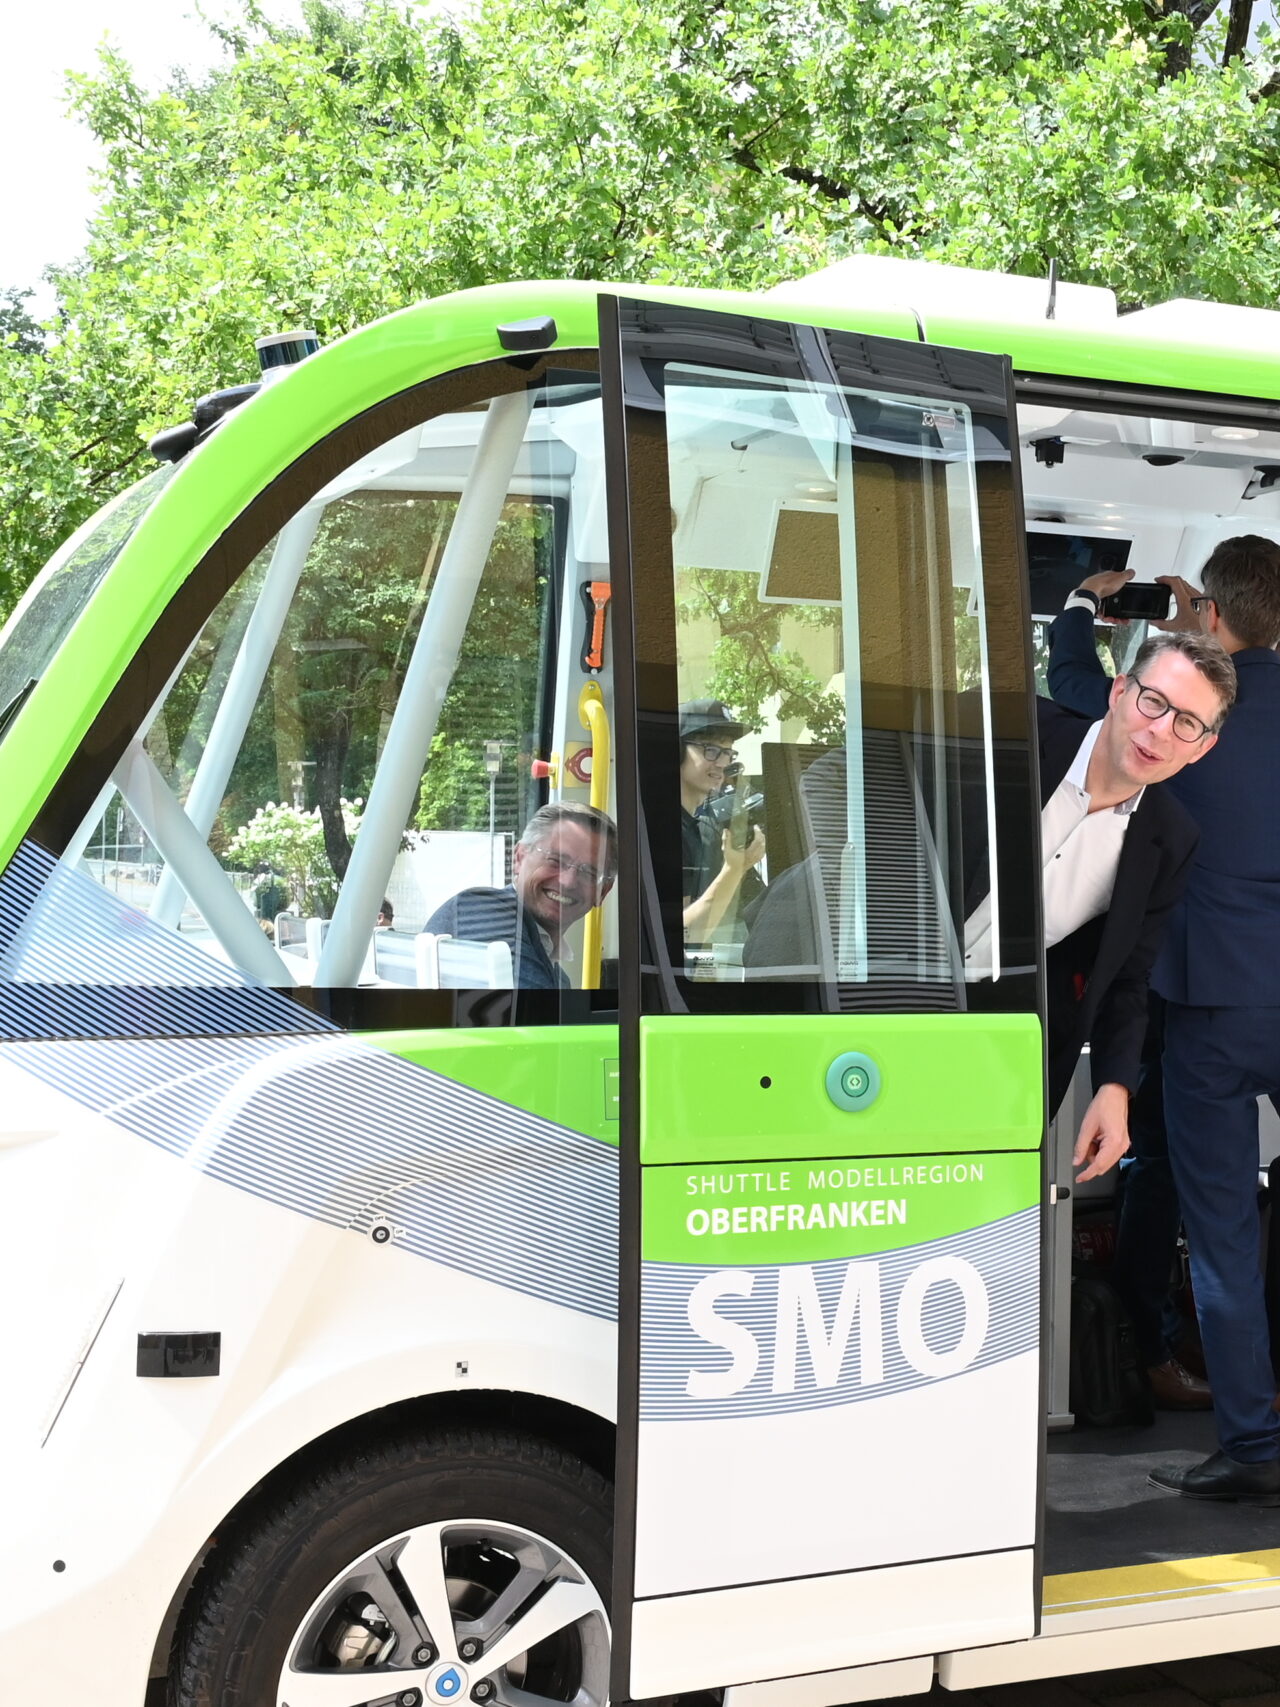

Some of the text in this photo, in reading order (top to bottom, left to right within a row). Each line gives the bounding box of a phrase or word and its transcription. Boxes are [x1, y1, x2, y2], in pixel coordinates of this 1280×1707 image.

[686, 1164, 985, 1195] SHUTTLE MODELLREGION
[686, 1199, 907, 1236] OBERFRANKEN
[686, 1256, 990, 1397] SMO
